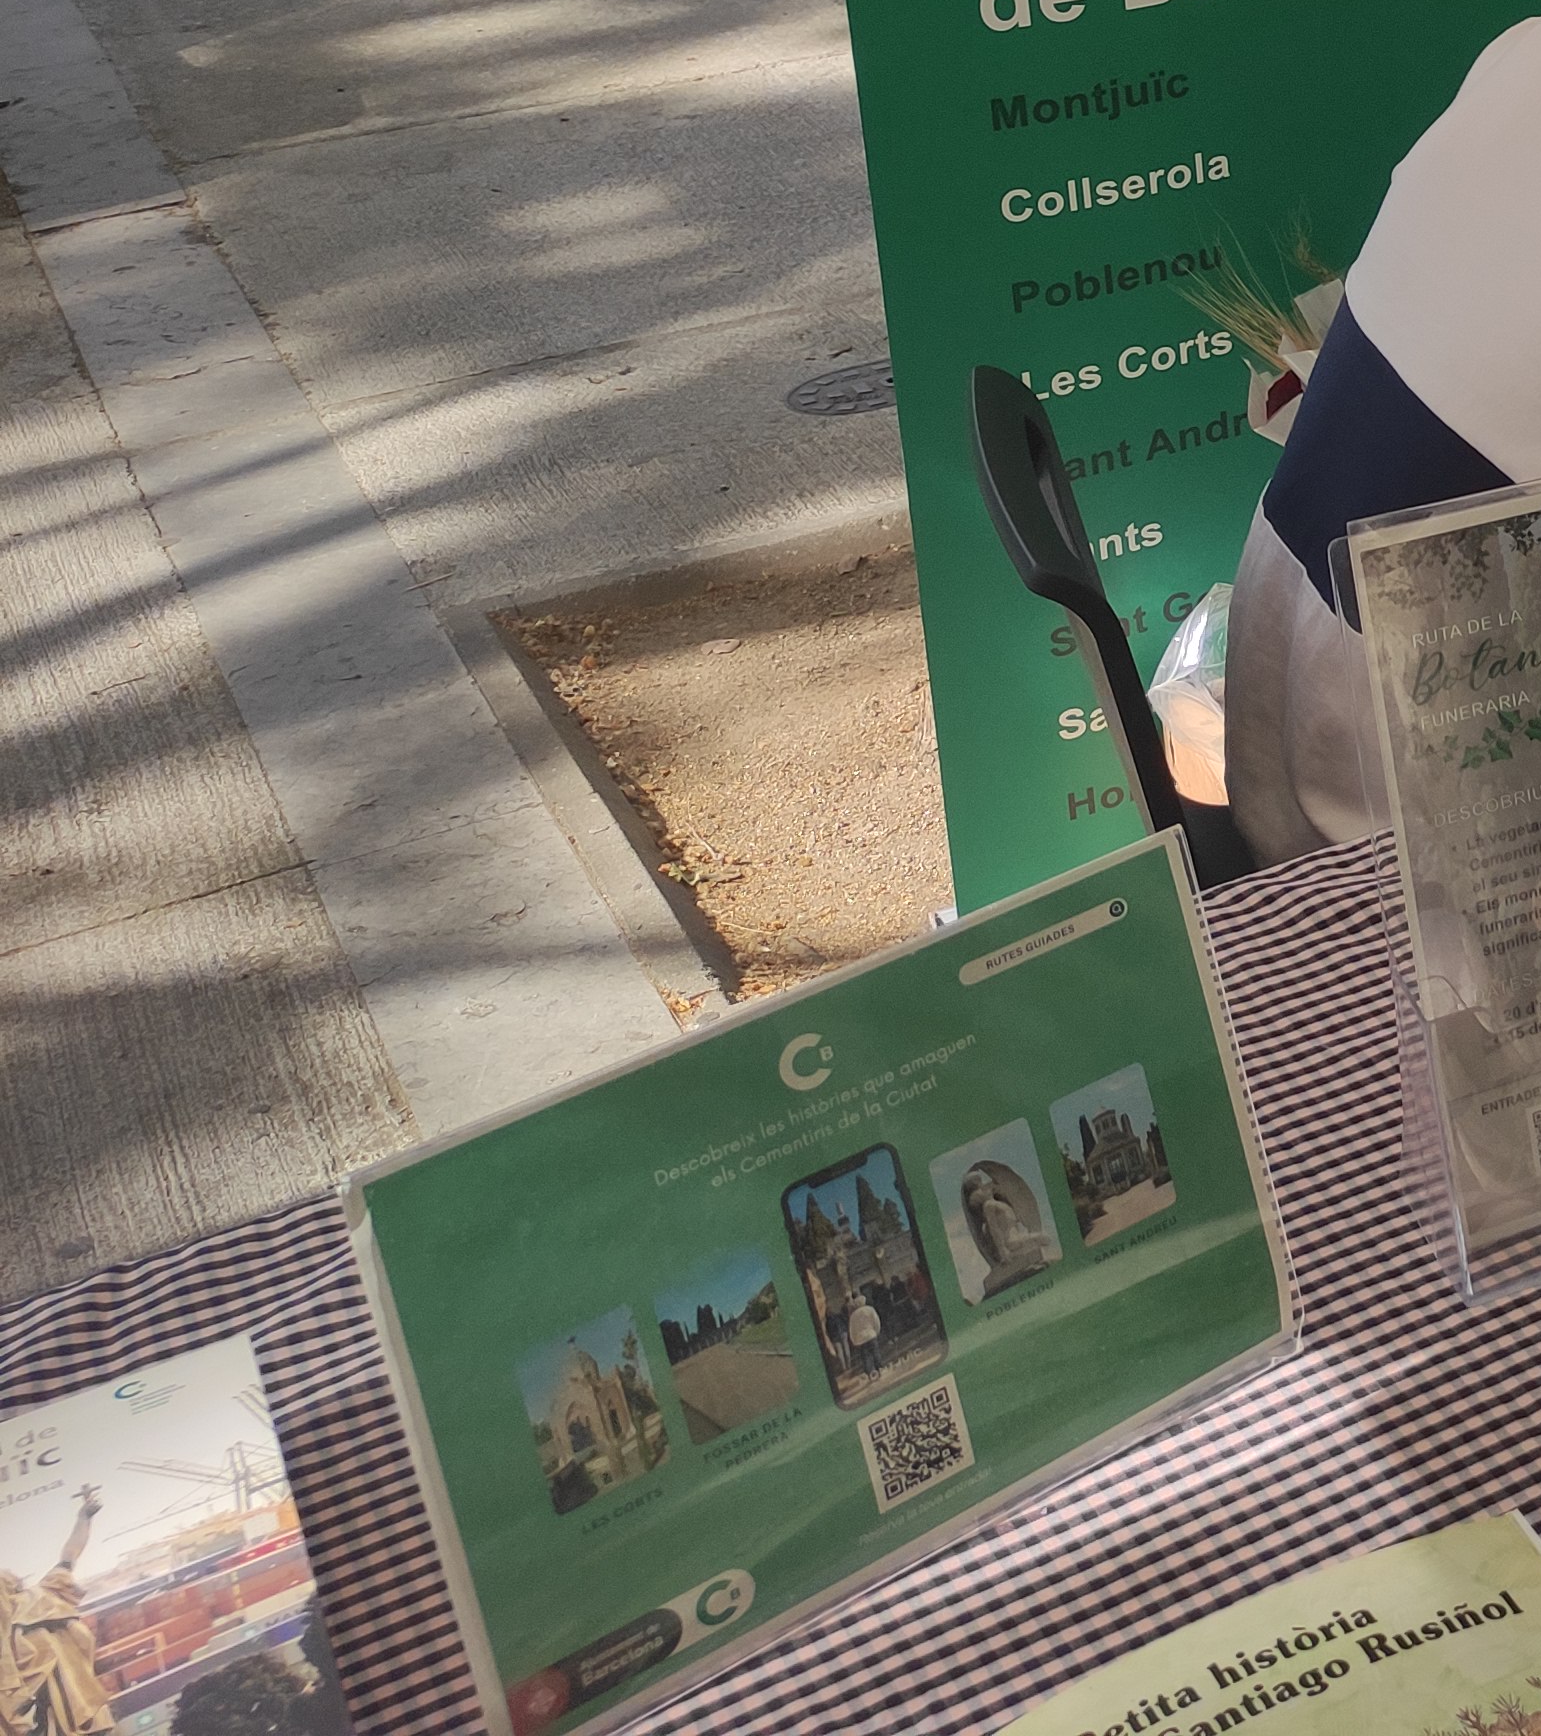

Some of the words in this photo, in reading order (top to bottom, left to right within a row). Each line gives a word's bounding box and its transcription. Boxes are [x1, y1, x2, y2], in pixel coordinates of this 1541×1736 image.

[989, 68, 1191, 131] Montjuïc
[1000, 151, 1231, 223] Collserola
[1011, 243, 1224, 313] Poblenou
[1020, 360, 1102, 403] Les
[1117, 328, 1233, 380] Corts
[1064, 439, 1133, 483] ant
[1146, 410, 1251, 463] Andr
[1089, 521, 1164, 562] nts
[1412, 623, 1462, 649] RUTA
[1467, 615, 1493, 635] DE
[1498, 609, 1523, 628] LA
[1420, 690, 1531, 731] FUNERARIA
[1472, 877, 1487, 894] el
[1490, 872, 1518, 889] seu
[1476, 898, 1501, 915] Els
[985, 946, 1024, 971] RUTES
[1025, 923, 1076, 955] GUIADES
[654, 1131, 757, 1187] Descobreix
[760, 1114, 785, 1138] les
[788, 1089, 860, 1127] històries
[864, 1071, 896, 1101] que
[900, 1032, 977, 1078] amaguen
[711, 1167, 736, 1189] els
[739, 1125, 834, 1173] Cementiris
[837, 1108, 860, 1128] de
[864, 1098, 883, 1119] la
[886, 1074, 939, 1112] Ciutat
[1094, 1244, 1127, 1265] SANT
[1130, 1215, 1178, 1248] ANDREU
[985, 1280, 1055, 1321] POBLENOU
[15, 1425, 58, 1448] de
[724, 1431, 789, 1470] PEDRERA
[1206, 1606, 1378, 1692] història
[1355, 1589, 1525, 1666] Rusiñol
[581, 1635, 665, 1687] Barcelona
